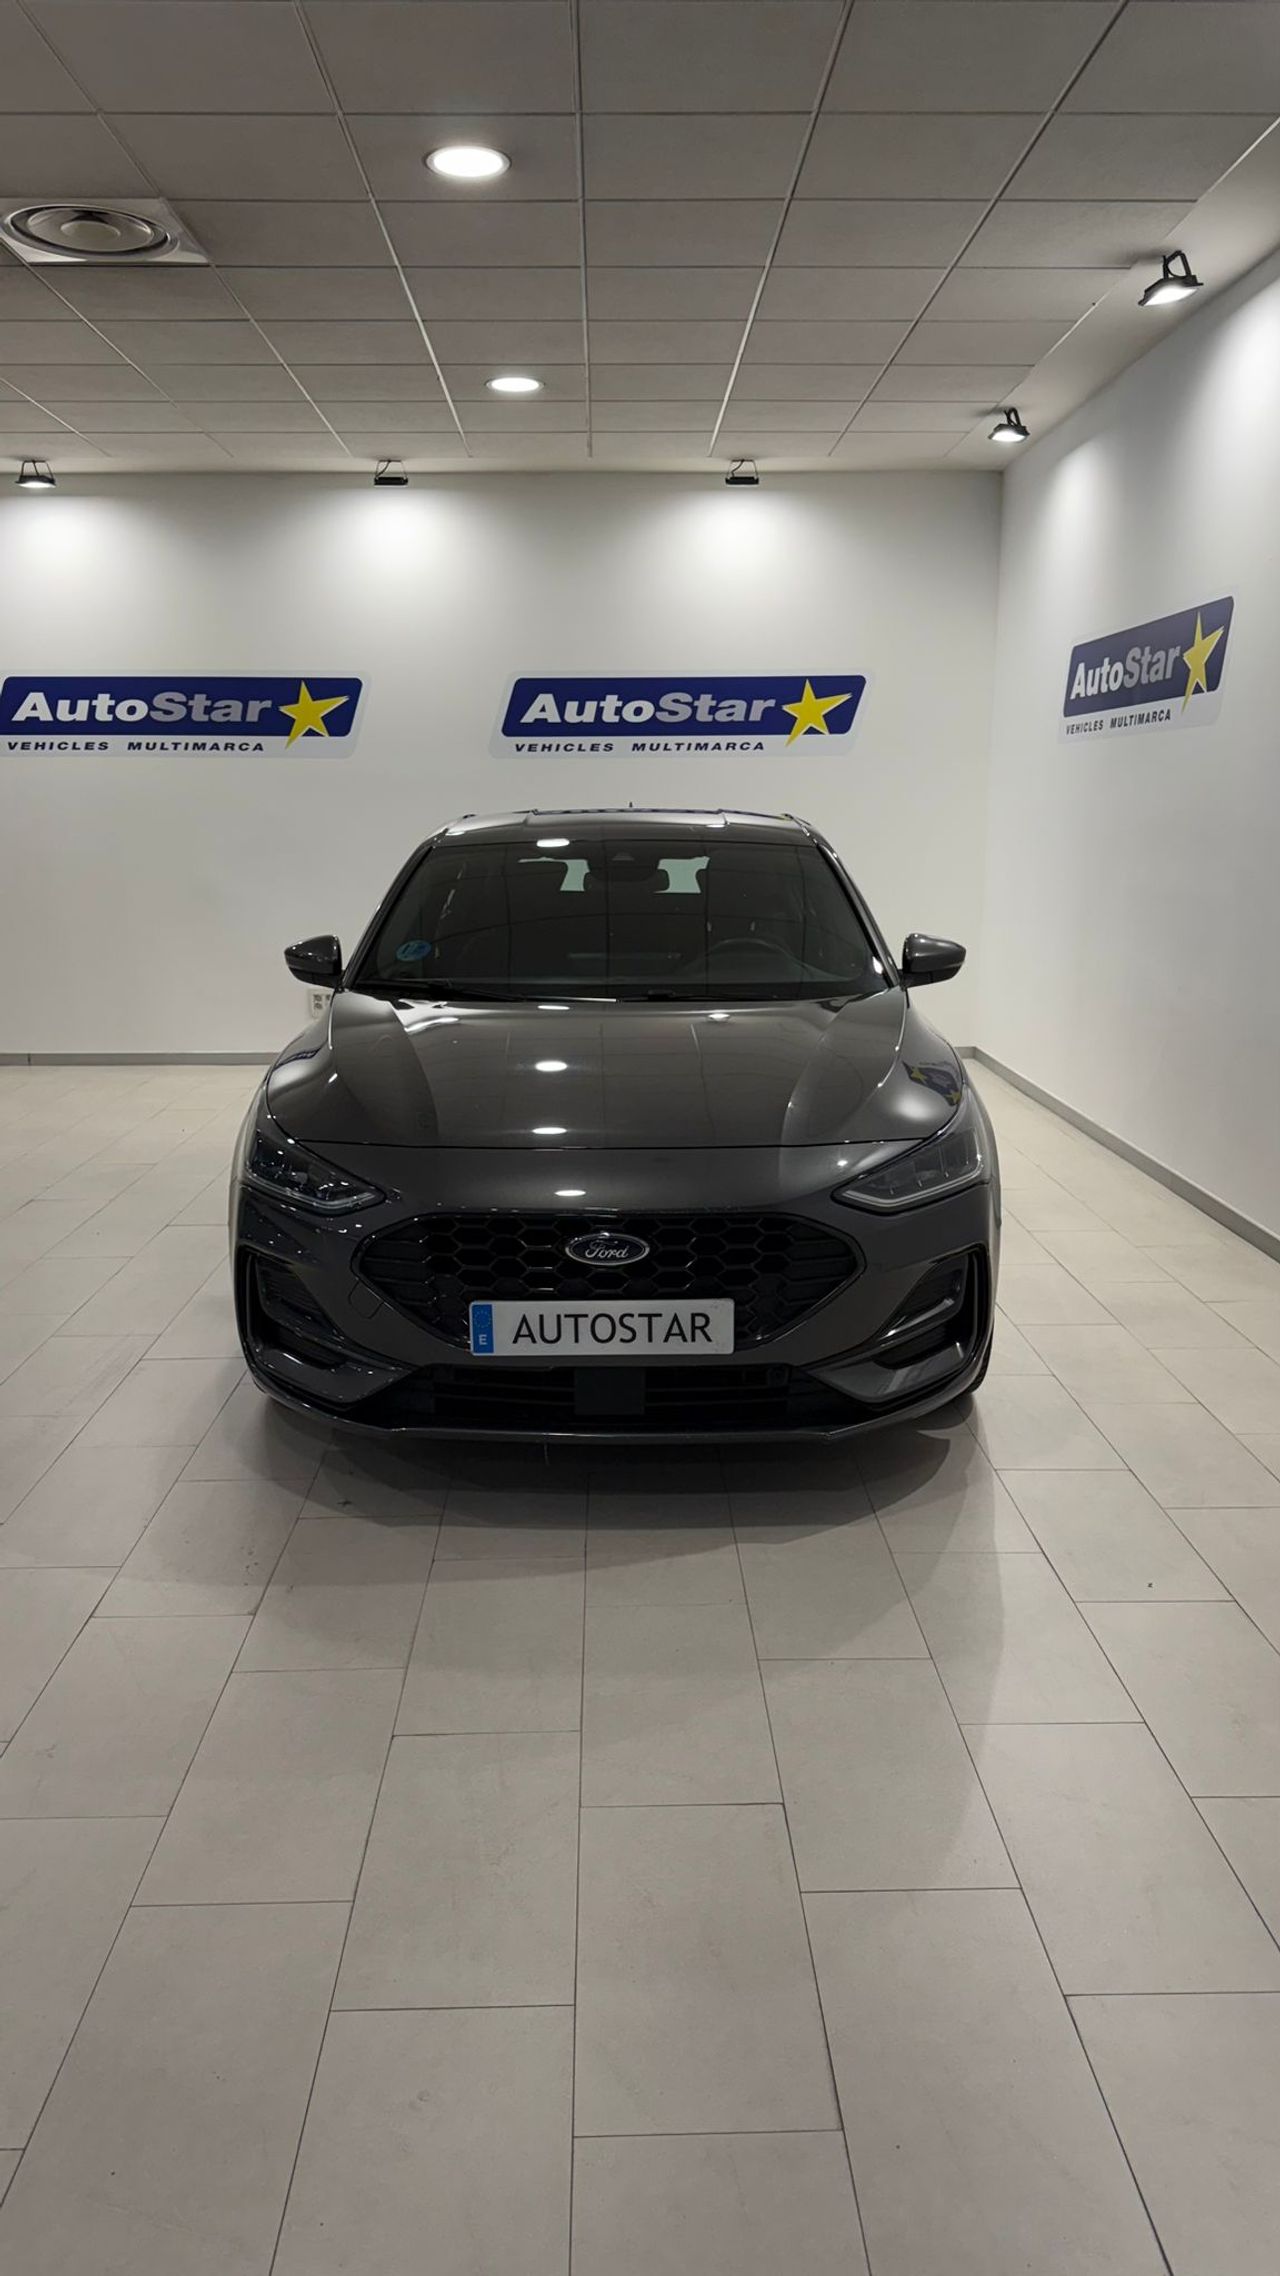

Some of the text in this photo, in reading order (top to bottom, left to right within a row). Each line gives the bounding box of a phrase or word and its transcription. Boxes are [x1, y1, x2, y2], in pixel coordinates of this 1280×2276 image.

[1070, 646, 1181, 699] AutoStar
[11, 691, 272, 722] AutoStar
[520, 692, 776, 724] AutoStar
[1066, 709, 1171, 735] VEHICLES MULTIMARCA
[8, 741, 264, 751] VEHICLES MULTIMARCA
[515, 742, 765, 752] VEHICLES MULTIMARCA
[585, 1240, 629, 1259] Ford
[478, 1334, 488, 1346] E
[512, 1312, 713, 1344] AUTOSTAR
